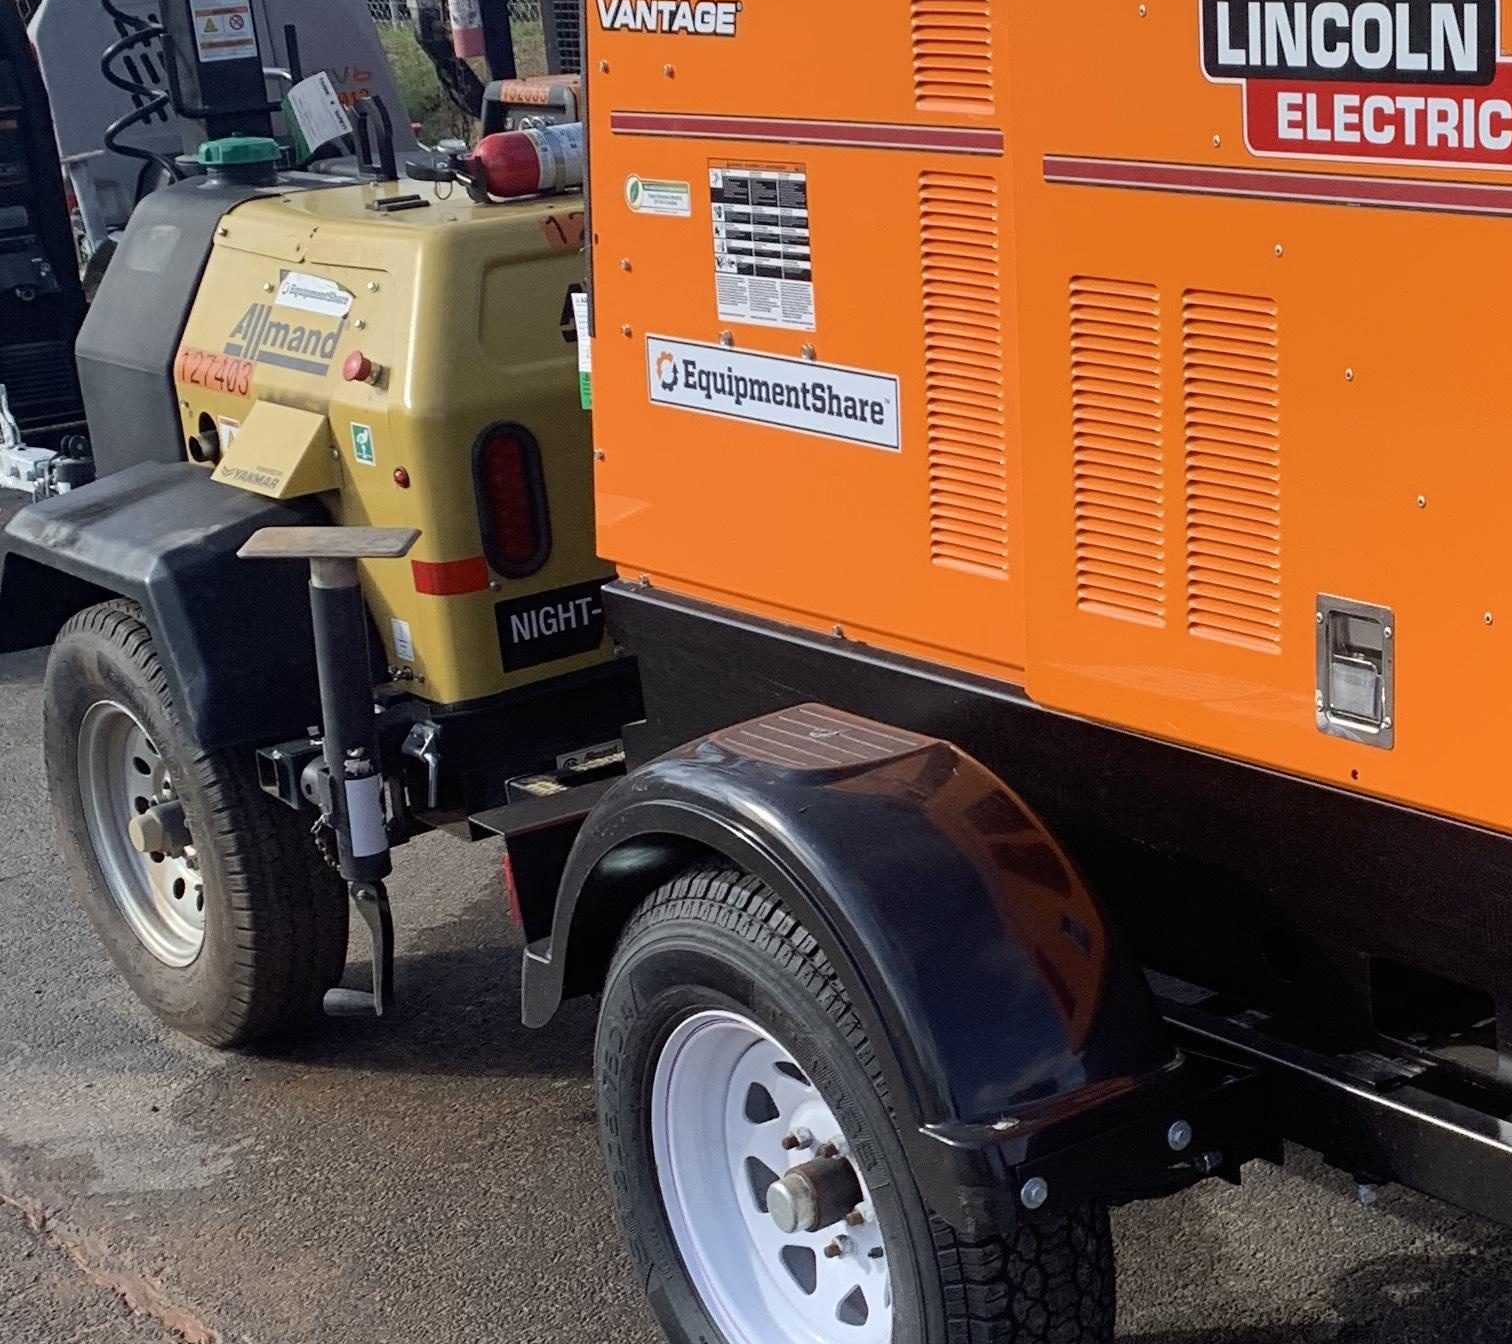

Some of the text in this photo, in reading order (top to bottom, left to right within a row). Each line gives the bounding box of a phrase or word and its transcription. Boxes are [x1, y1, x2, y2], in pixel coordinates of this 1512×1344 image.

[1216, 1, 1478, 72] LINCOLN
[1276, 91, 1512, 151] ELECTRIC
[289, 284, 350, 305] EquipmentShare
[229, 303, 346, 360] Allmand
[180, 352, 250, 396] 127403
[682, 359, 884, 425] EquipmentShare
[234, 467, 280, 489] YANMAR
[510, 597, 602, 643] NIGHT-
